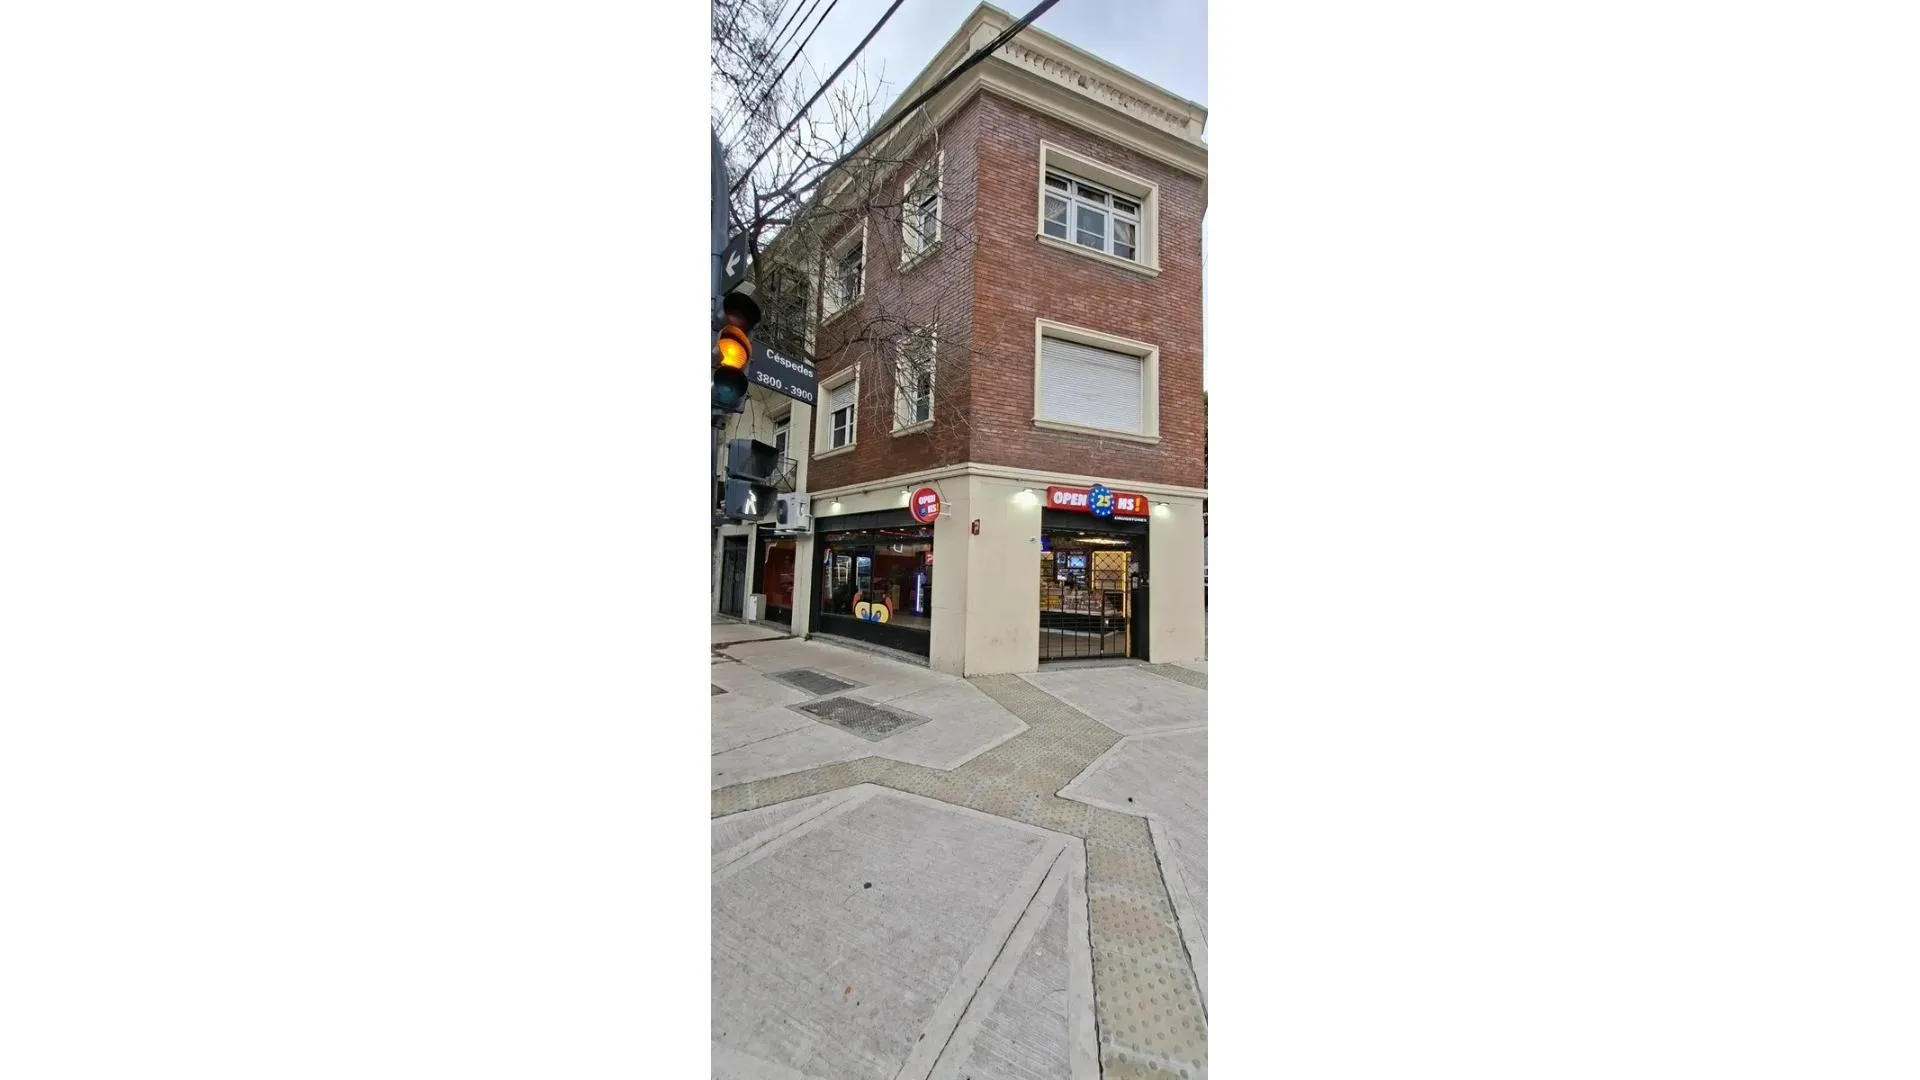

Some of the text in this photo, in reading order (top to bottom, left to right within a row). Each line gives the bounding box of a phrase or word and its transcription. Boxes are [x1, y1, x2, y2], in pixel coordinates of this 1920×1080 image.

[766, 349, 814, 378] Céspedes
[756, 371, 782, 389] 3800
[790, 385, 813, 402] 3900
[918, 495, 935, 505] OPEN
[1053, 491, 1088, 506] OPEN
[1096, 494, 1111, 507] 25
